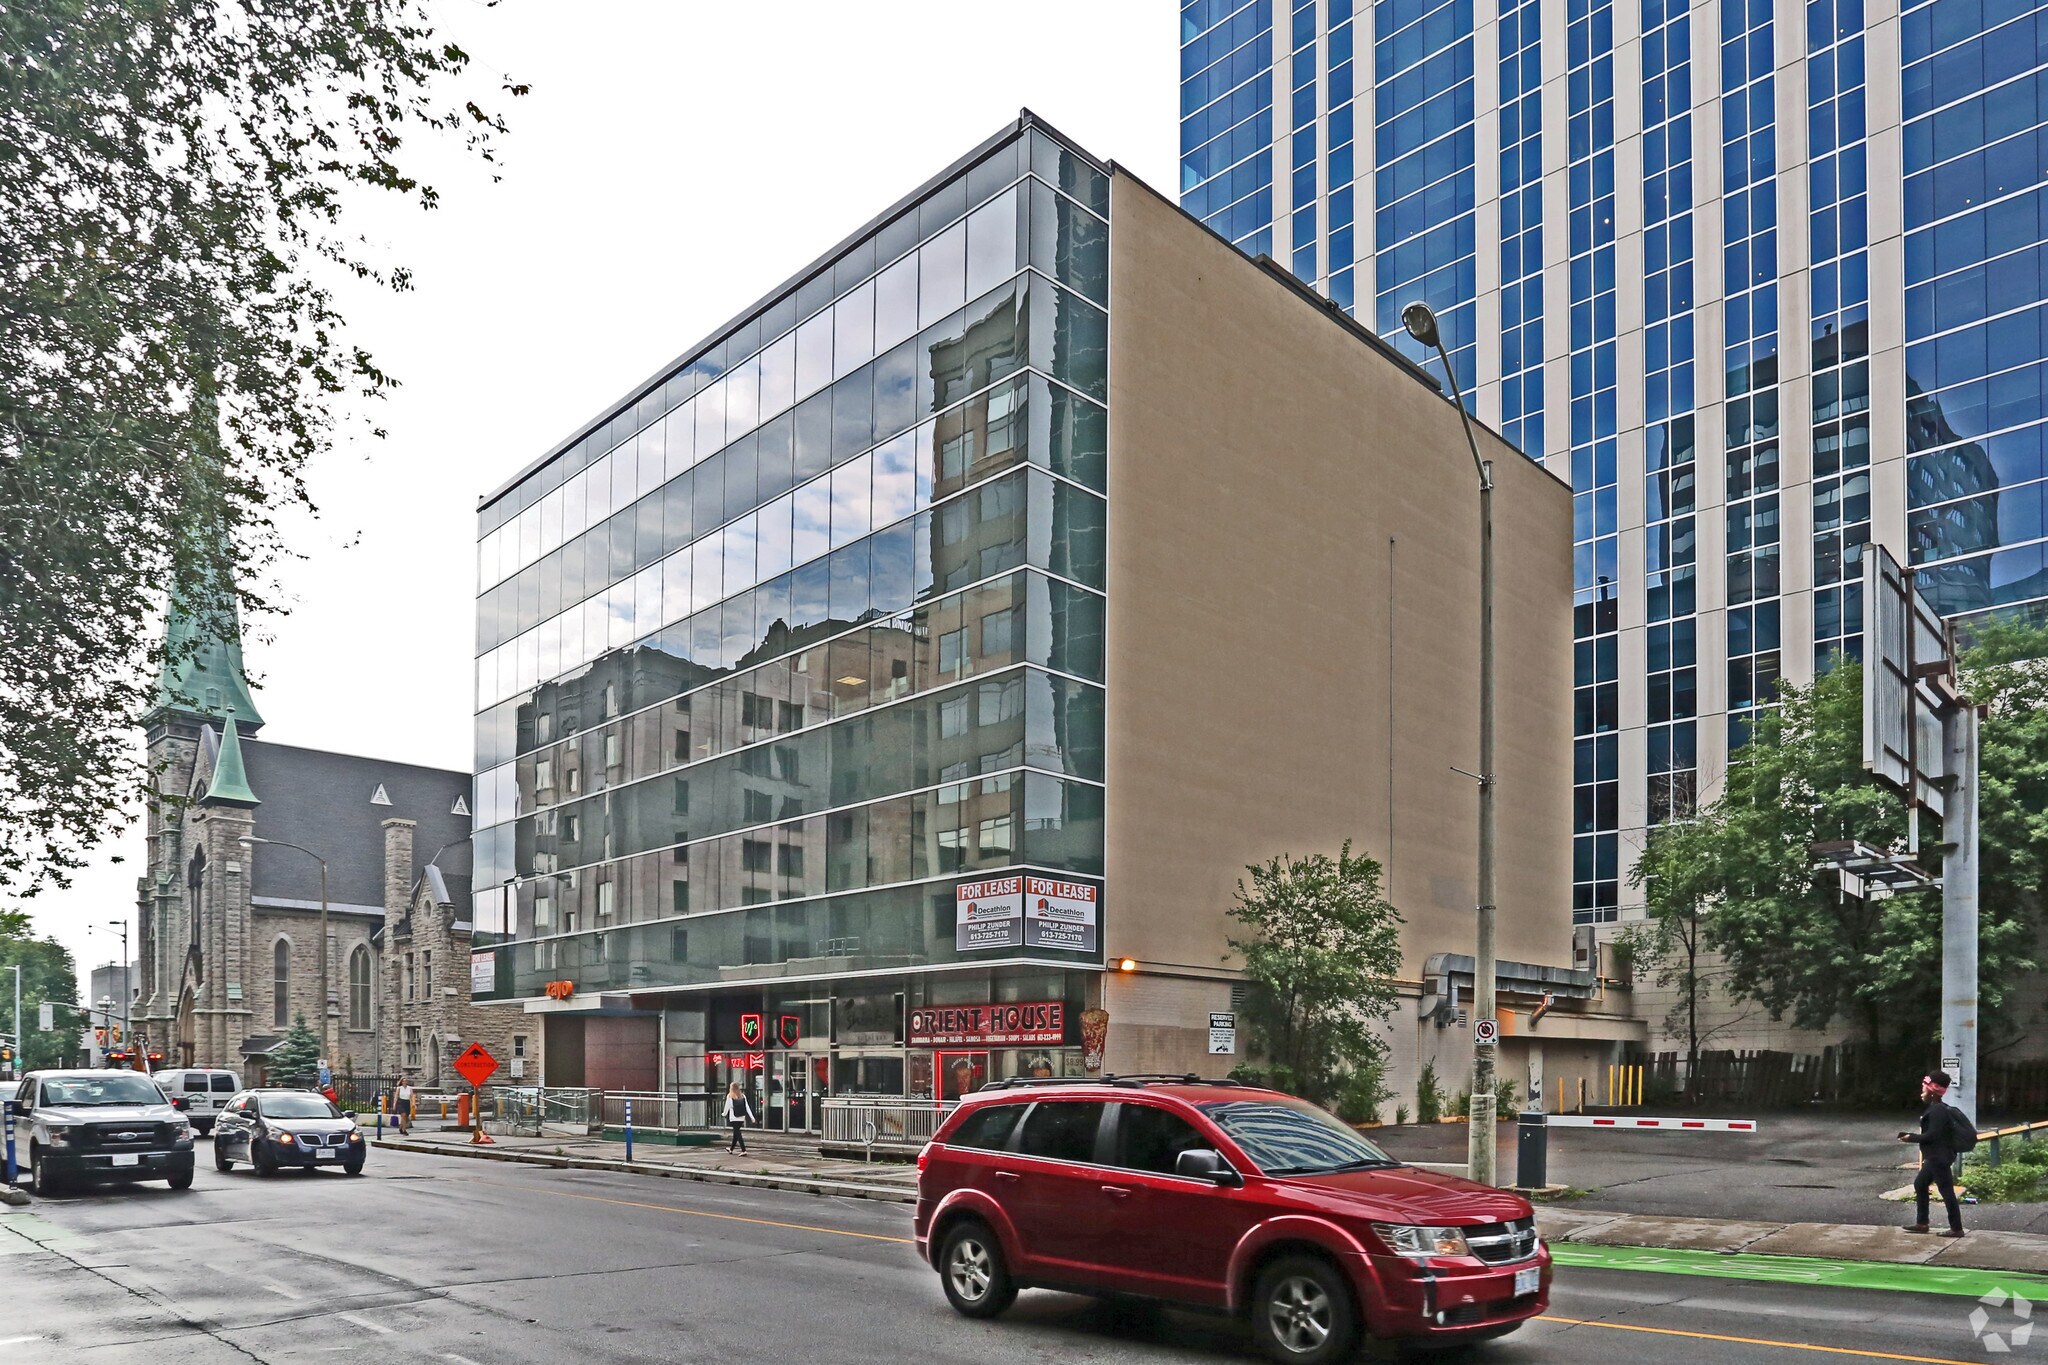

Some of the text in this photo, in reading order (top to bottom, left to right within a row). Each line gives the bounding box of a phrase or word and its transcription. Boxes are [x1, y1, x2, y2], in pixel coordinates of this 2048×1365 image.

[961, 880, 1017, 899] FOR LEASE
[1031, 880, 1091, 900] FOR LEASE
[978, 905, 1011, 914] Decathlon
[1049, 906, 1085, 917] Decathlon
[968, 923, 986, 931] PHILIP
[987, 921, 1011, 929] ZUNDER
[1038, 921, 1059, 929] PHILIP
[1060, 923, 1085, 932] ZUNDER
[970, 931, 1009, 940] 613-725-7170
[1041, 931, 1083, 942] 613-725-7170
[544, 981, 571, 1000] zayo
[911, 1009, 983, 1034] ORIENT
[990, 1004, 1062, 1033] HOUSE
[1066, 1057, 1084, 1067] $8.99
